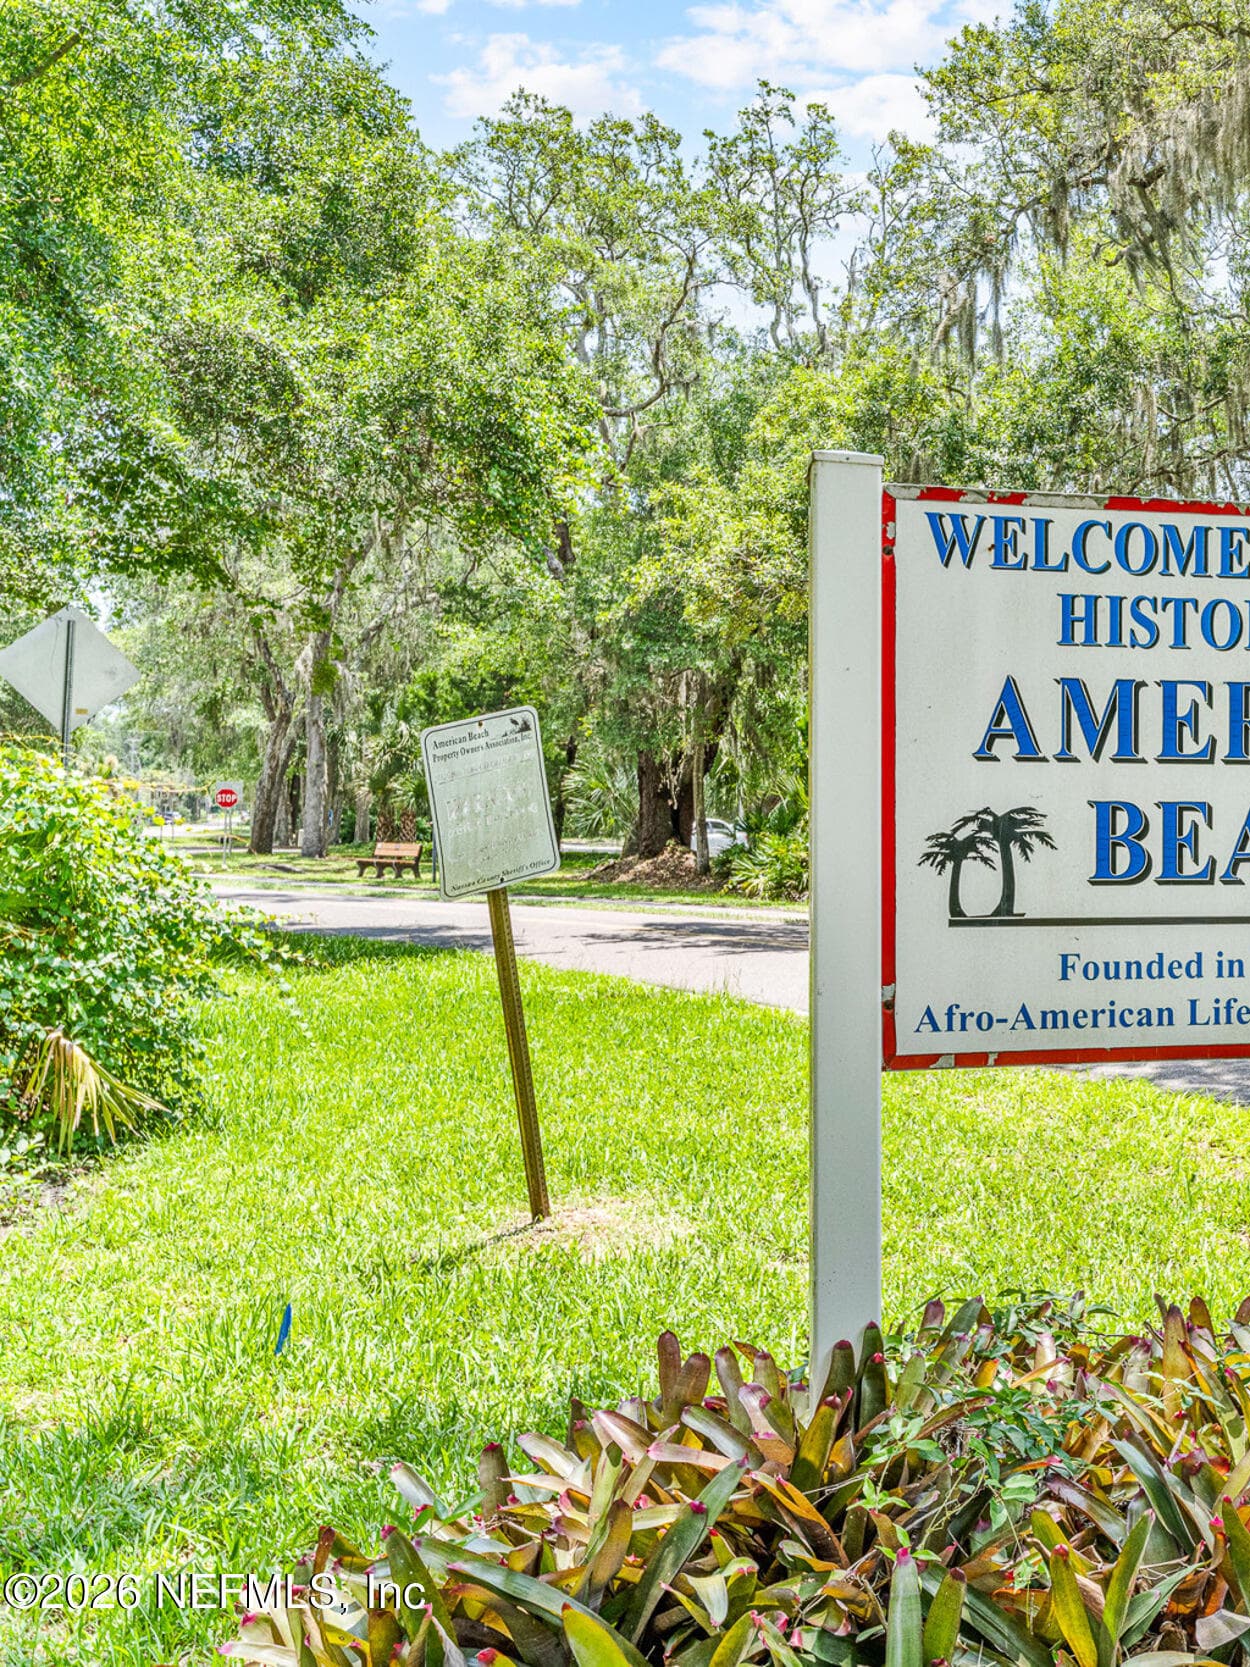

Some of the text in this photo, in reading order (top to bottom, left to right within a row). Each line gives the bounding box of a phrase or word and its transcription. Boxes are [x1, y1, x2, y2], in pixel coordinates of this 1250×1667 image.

[433, 729, 489, 750] American Beach
[432, 749, 459, 763] Property
[216, 794, 237, 803] STOP
[529, 859, 551, 870] Office
[1058, 951, 1204, 982] Founded
[1216, 951, 1246, 979] in
[913, 1000, 1176, 1034] Afro-American
